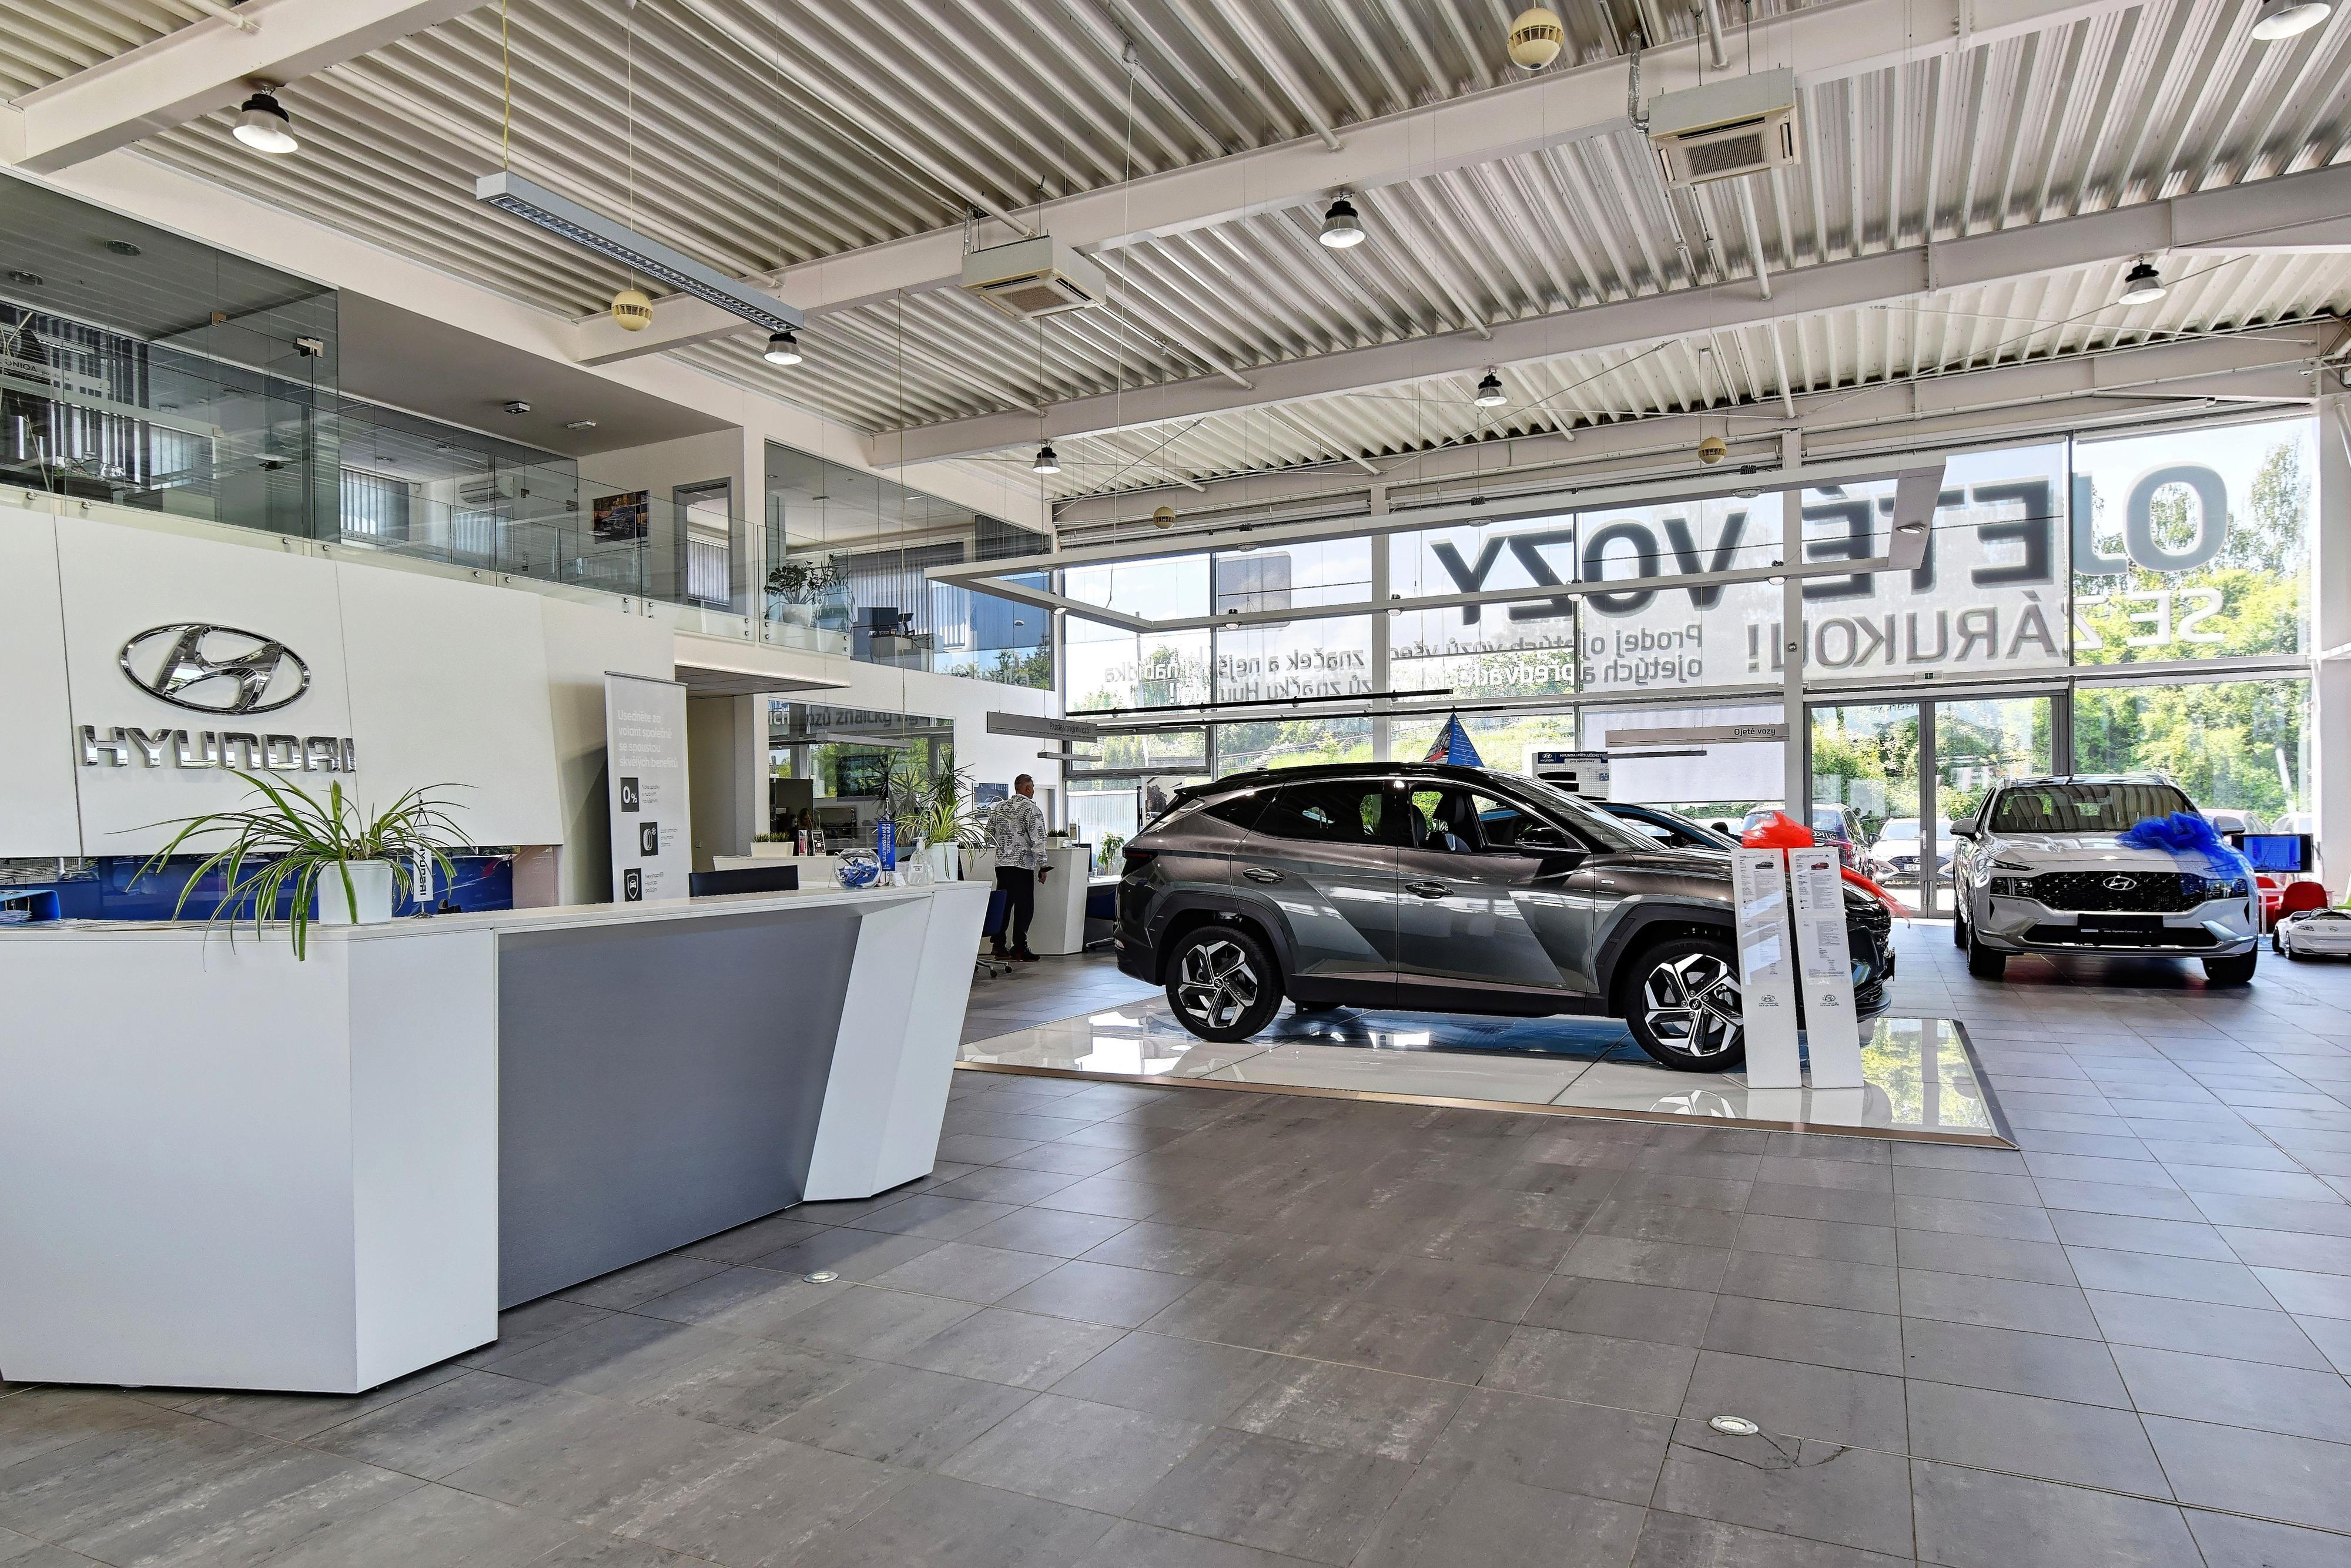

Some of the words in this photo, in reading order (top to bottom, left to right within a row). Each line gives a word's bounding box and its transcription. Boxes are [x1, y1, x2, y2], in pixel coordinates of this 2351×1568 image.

[5, 359, 37, 372] UNIQA
[617, 709, 652, 723] Usedněte
[618, 725, 641, 737] volant
[1049, 722, 1064, 733] Prodej
[1734, 728, 1755, 737] Ojeté
[1757, 728, 1776, 736] vozy
[79, 725, 357, 773] HYUNDAI
[619, 742, 628, 752] se
[628, 743, 661, 754] spoustou
[623, 786, 638, 804] 0%
